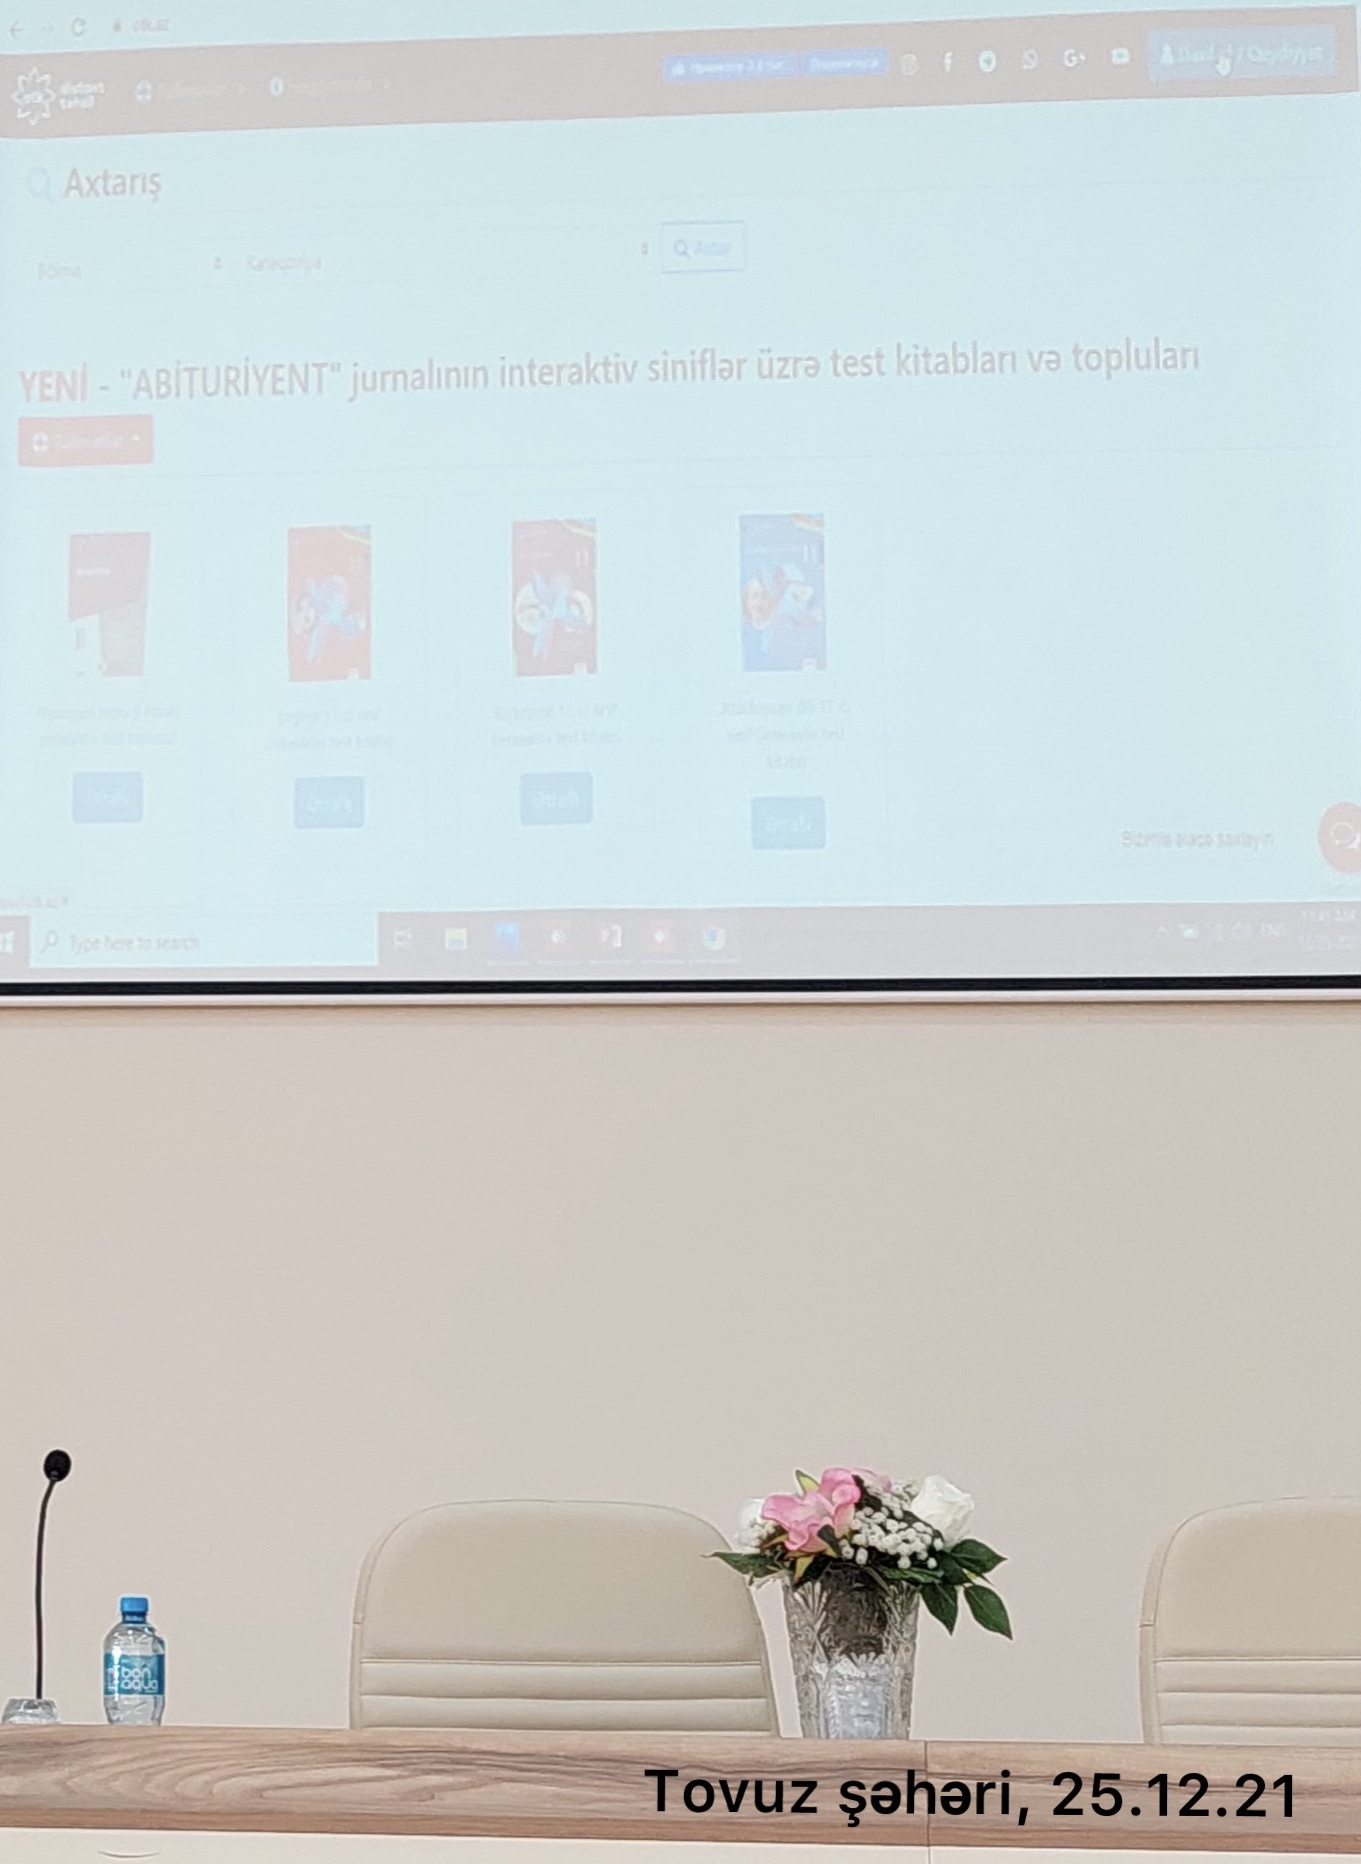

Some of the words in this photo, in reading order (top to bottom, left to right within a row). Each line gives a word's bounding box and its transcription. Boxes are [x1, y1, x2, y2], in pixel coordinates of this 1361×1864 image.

[63, 166, 162, 202] Axtarış
[18, 361, 89, 403] YENİ
[119, 357, 342, 401] "ABİTURİYENT"
[348, 357, 490, 403] jurnalının
[499, 352, 639, 389] interaktiv
[647, 348, 748, 384] siniflər
[756, 347, 821, 381] üzrə
[830, 346, 887, 378] test
[895, 340, 1017, 377] kitabları
[1027, 348, 1062, 373] və
[1070, 333, 1201, 381] topluları
